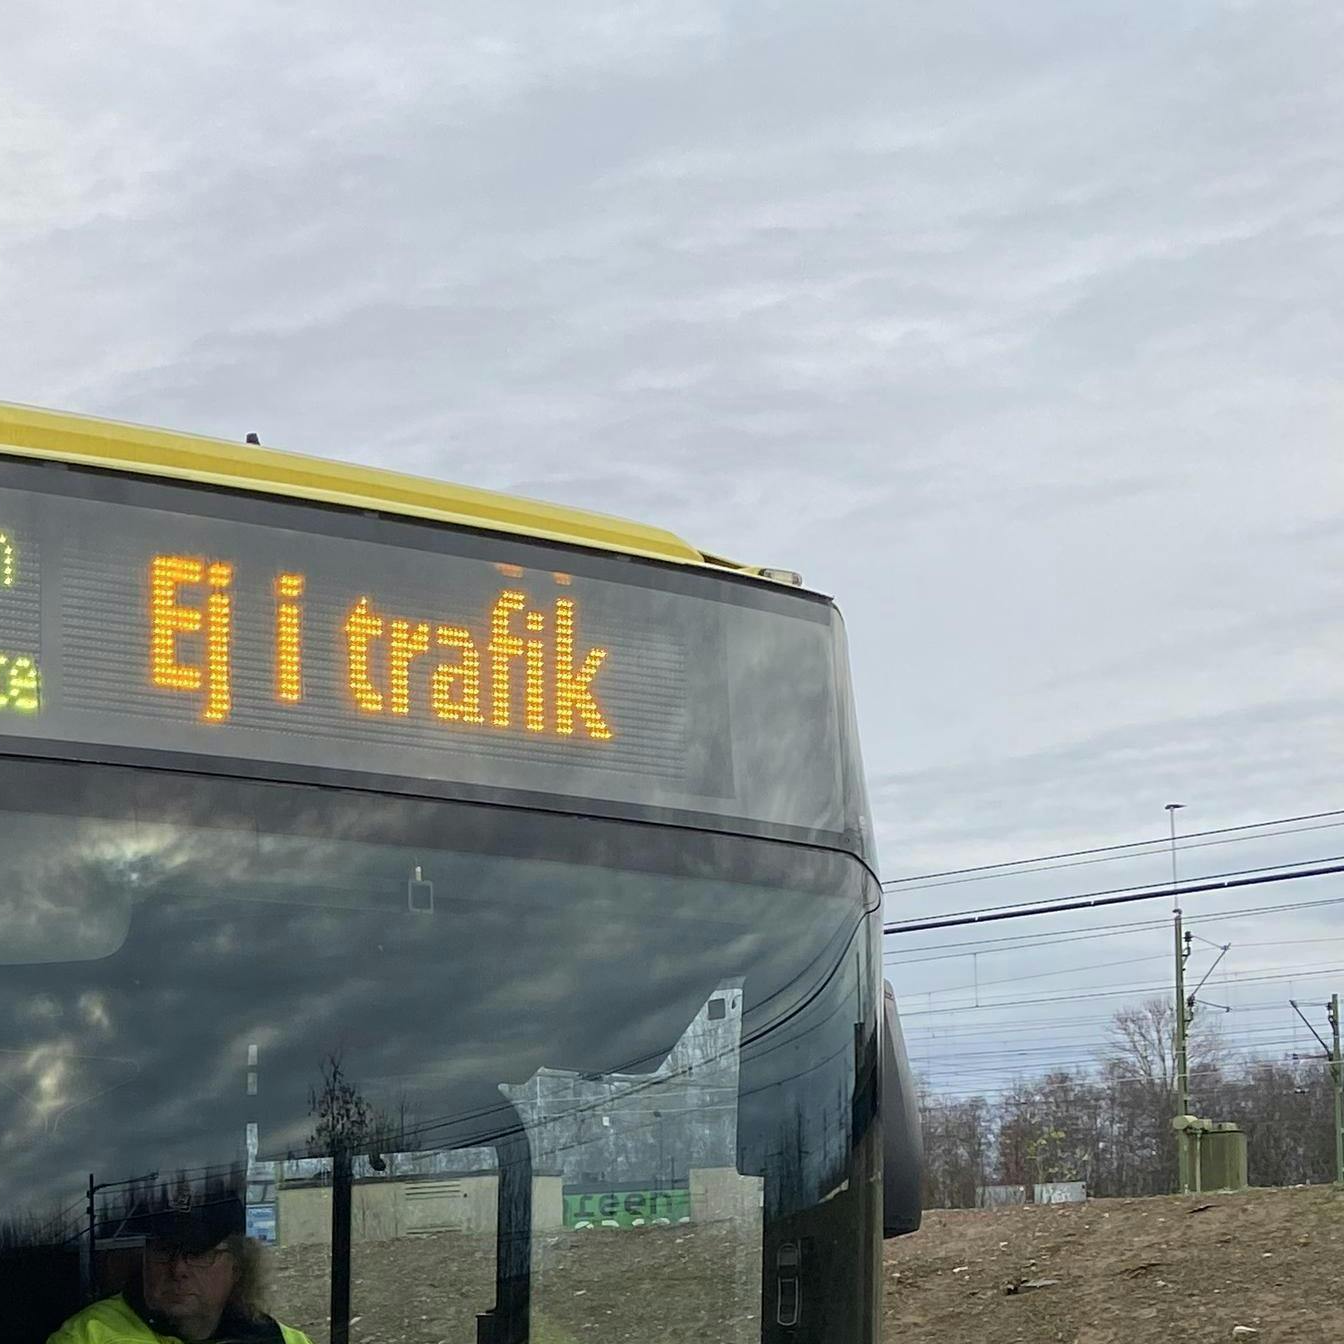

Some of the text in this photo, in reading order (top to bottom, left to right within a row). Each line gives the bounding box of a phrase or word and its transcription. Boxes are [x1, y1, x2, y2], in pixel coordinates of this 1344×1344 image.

[150, 555, 612, 740] Ej i trafik
[563, 1191, 673, 1219] reen
